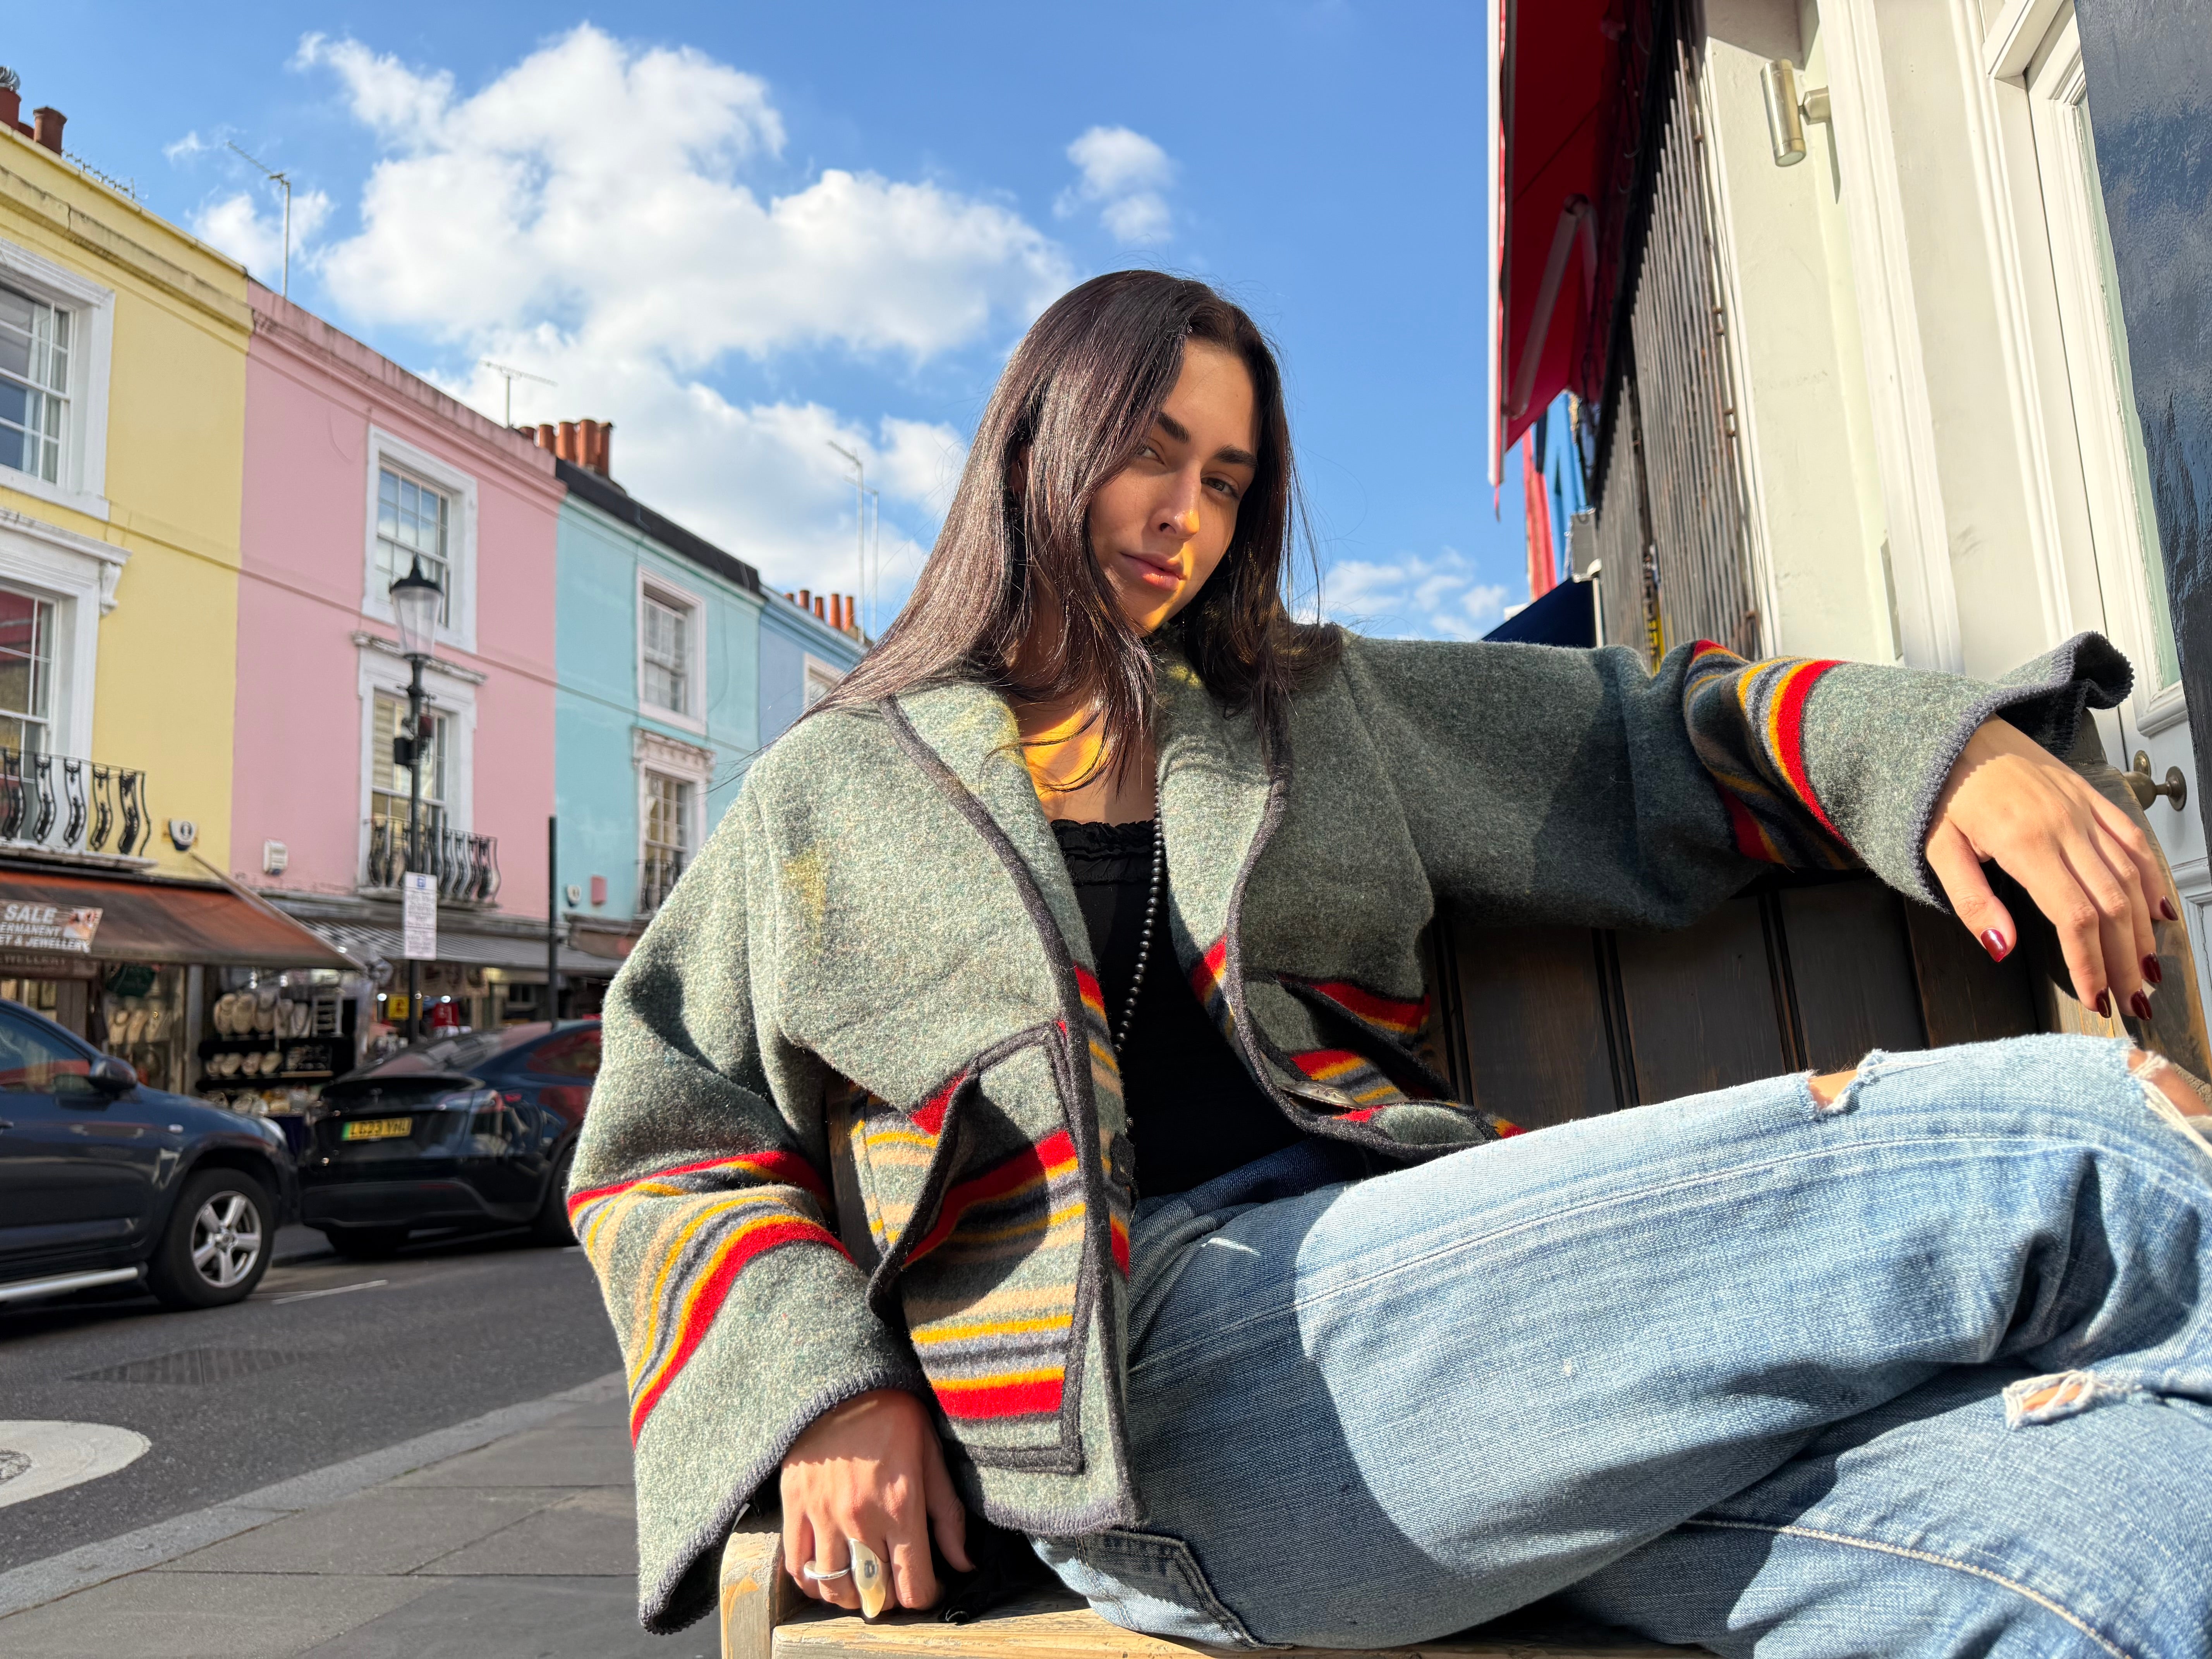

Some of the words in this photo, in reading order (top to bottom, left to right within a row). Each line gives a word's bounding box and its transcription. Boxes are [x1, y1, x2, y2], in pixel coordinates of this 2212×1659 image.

[4, 904, 57, 924] SALE
[14, 935, 23, 946] &
[26, 936, 91, 953] JEWELLERY
